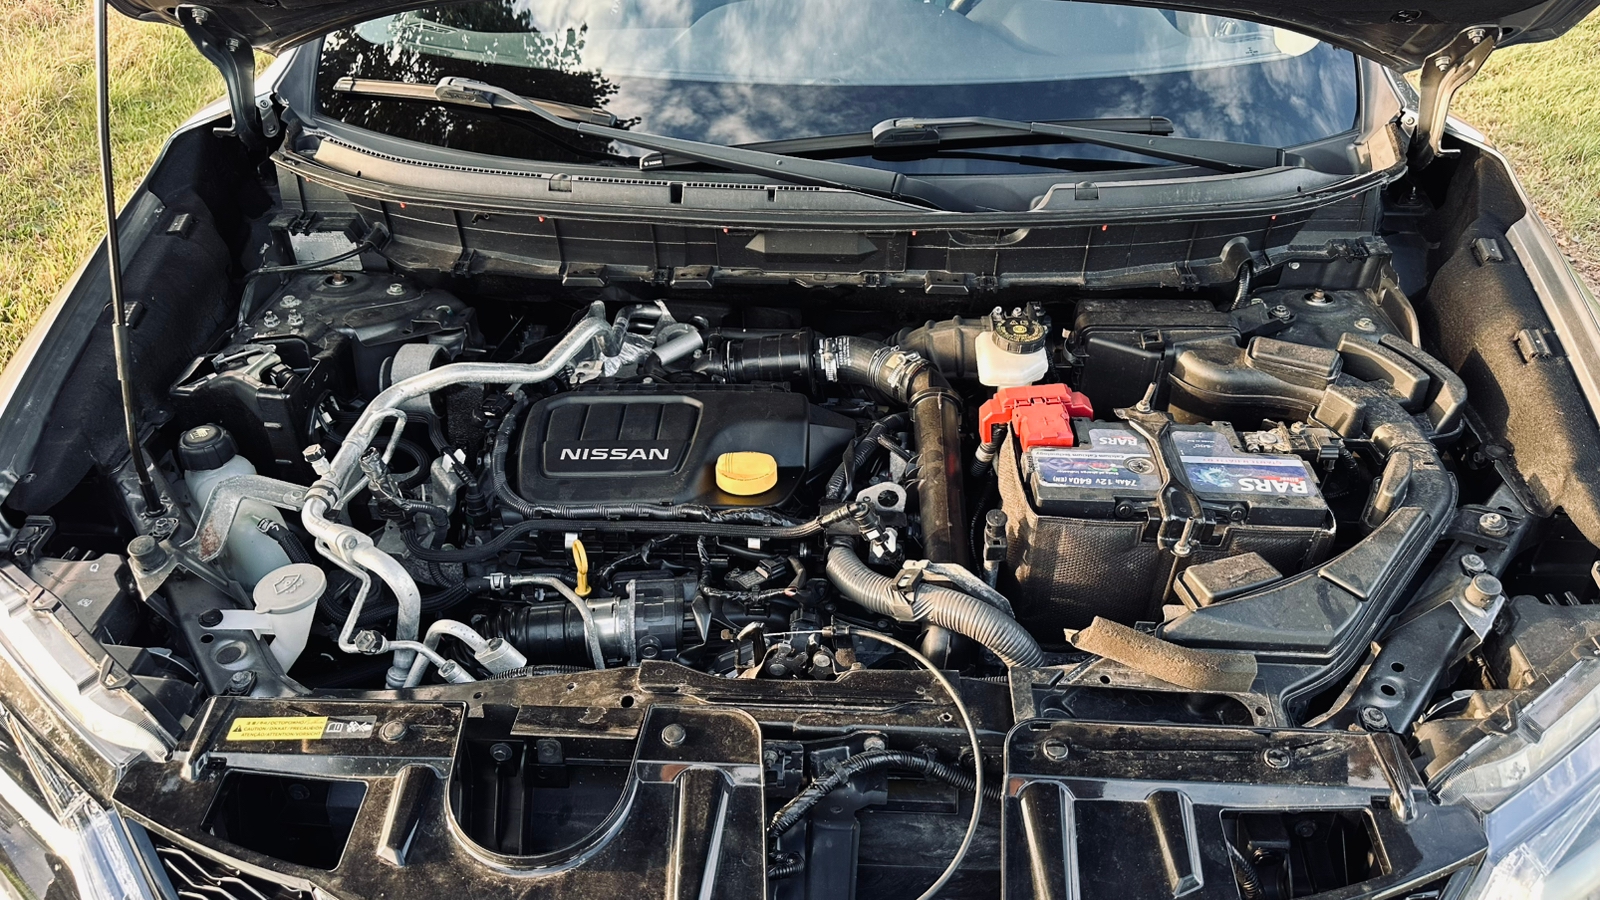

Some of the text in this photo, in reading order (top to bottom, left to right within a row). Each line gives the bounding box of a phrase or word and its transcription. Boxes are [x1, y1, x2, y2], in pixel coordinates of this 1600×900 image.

[1099, 436, 1138, 446] BARS
[560, 448, 670, 460] NISSAN
[1068, 477, 1092, 485] 640A
[1115, 478, 1138, 487] 74Ah
[1238, 477, 1308, 494] BARS
